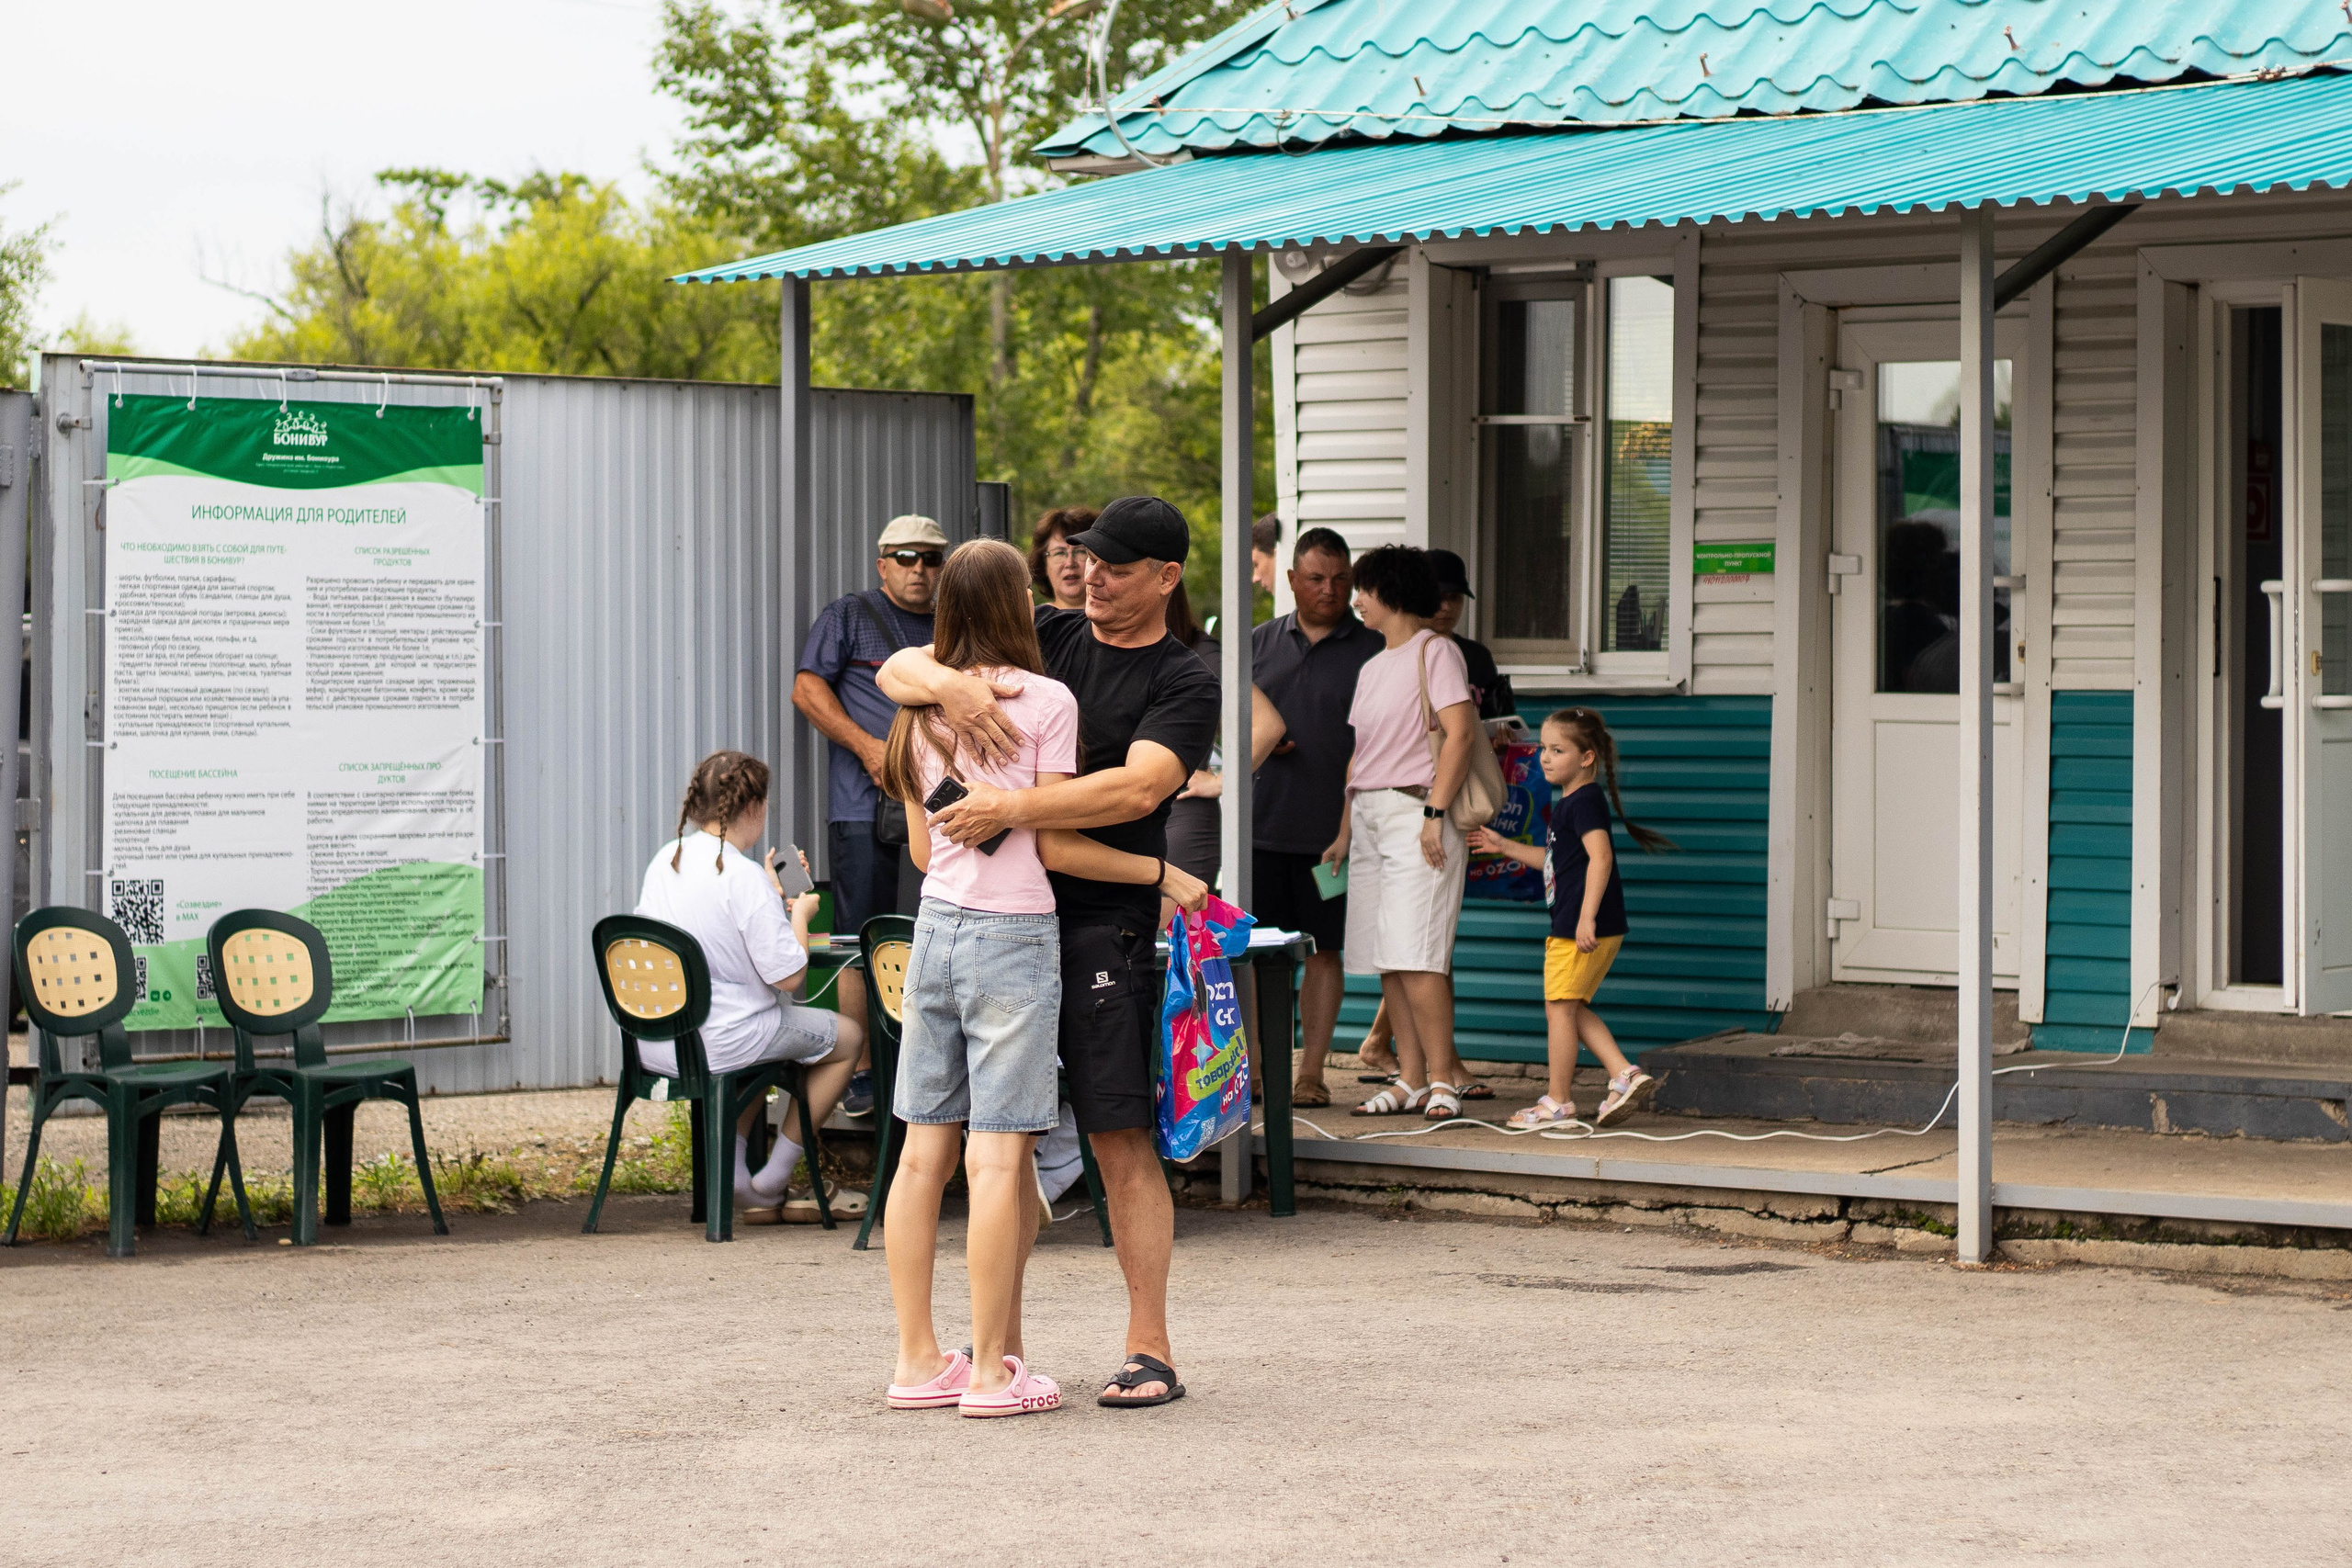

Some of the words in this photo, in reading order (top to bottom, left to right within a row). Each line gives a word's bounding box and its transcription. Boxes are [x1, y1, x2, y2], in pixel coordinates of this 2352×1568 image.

[273, 433, 328, 446] БОНИВУР
[192, 505, 293, 524] ИНФОРМАЦИЯ
[296, 507, 323, 525] ДЛЯ
[327, 507, 406, 525] РОДИТЕЛЕЙ
[120, 542, 136, 551] ЧТО
[137, 543, 191, 553] НЕОБХОДИМО
[192, 544, 215, 553] ВЗЯТЬ
[216, 545, 220, 553] С
[222, 545, 249, 553] СОБОЙ
[250, 545, 266, 554] ДЛЯ
[266, 546, 287, 554] ПУТЕ-
[355, 547, 382, 555] СПИСОК
[164, 556, 199, 564] ШЕСТВИЯ
[201, 556, 206, 564] В
[208, 557, 245, 565] БОНИВУР?
[373, 558, 413, 567] ПРОДУКТОВ
[339, 763, 369, 772] СПИСОК
[371, 761, 425, 772] ЗАПРЕЩЁННЫХ
[426, 761, 443, 771] ПРО-
[149, 770, 197, 779] ПОСЕЩЕНИЕ
[198, 769, 238, 778] БАССЕЙНА
[378, 775, 406, 784] ДУКТОВ
[1091, 980, 1116, 990] salomon
[1022, 1393, 1059, 1409] crocs
